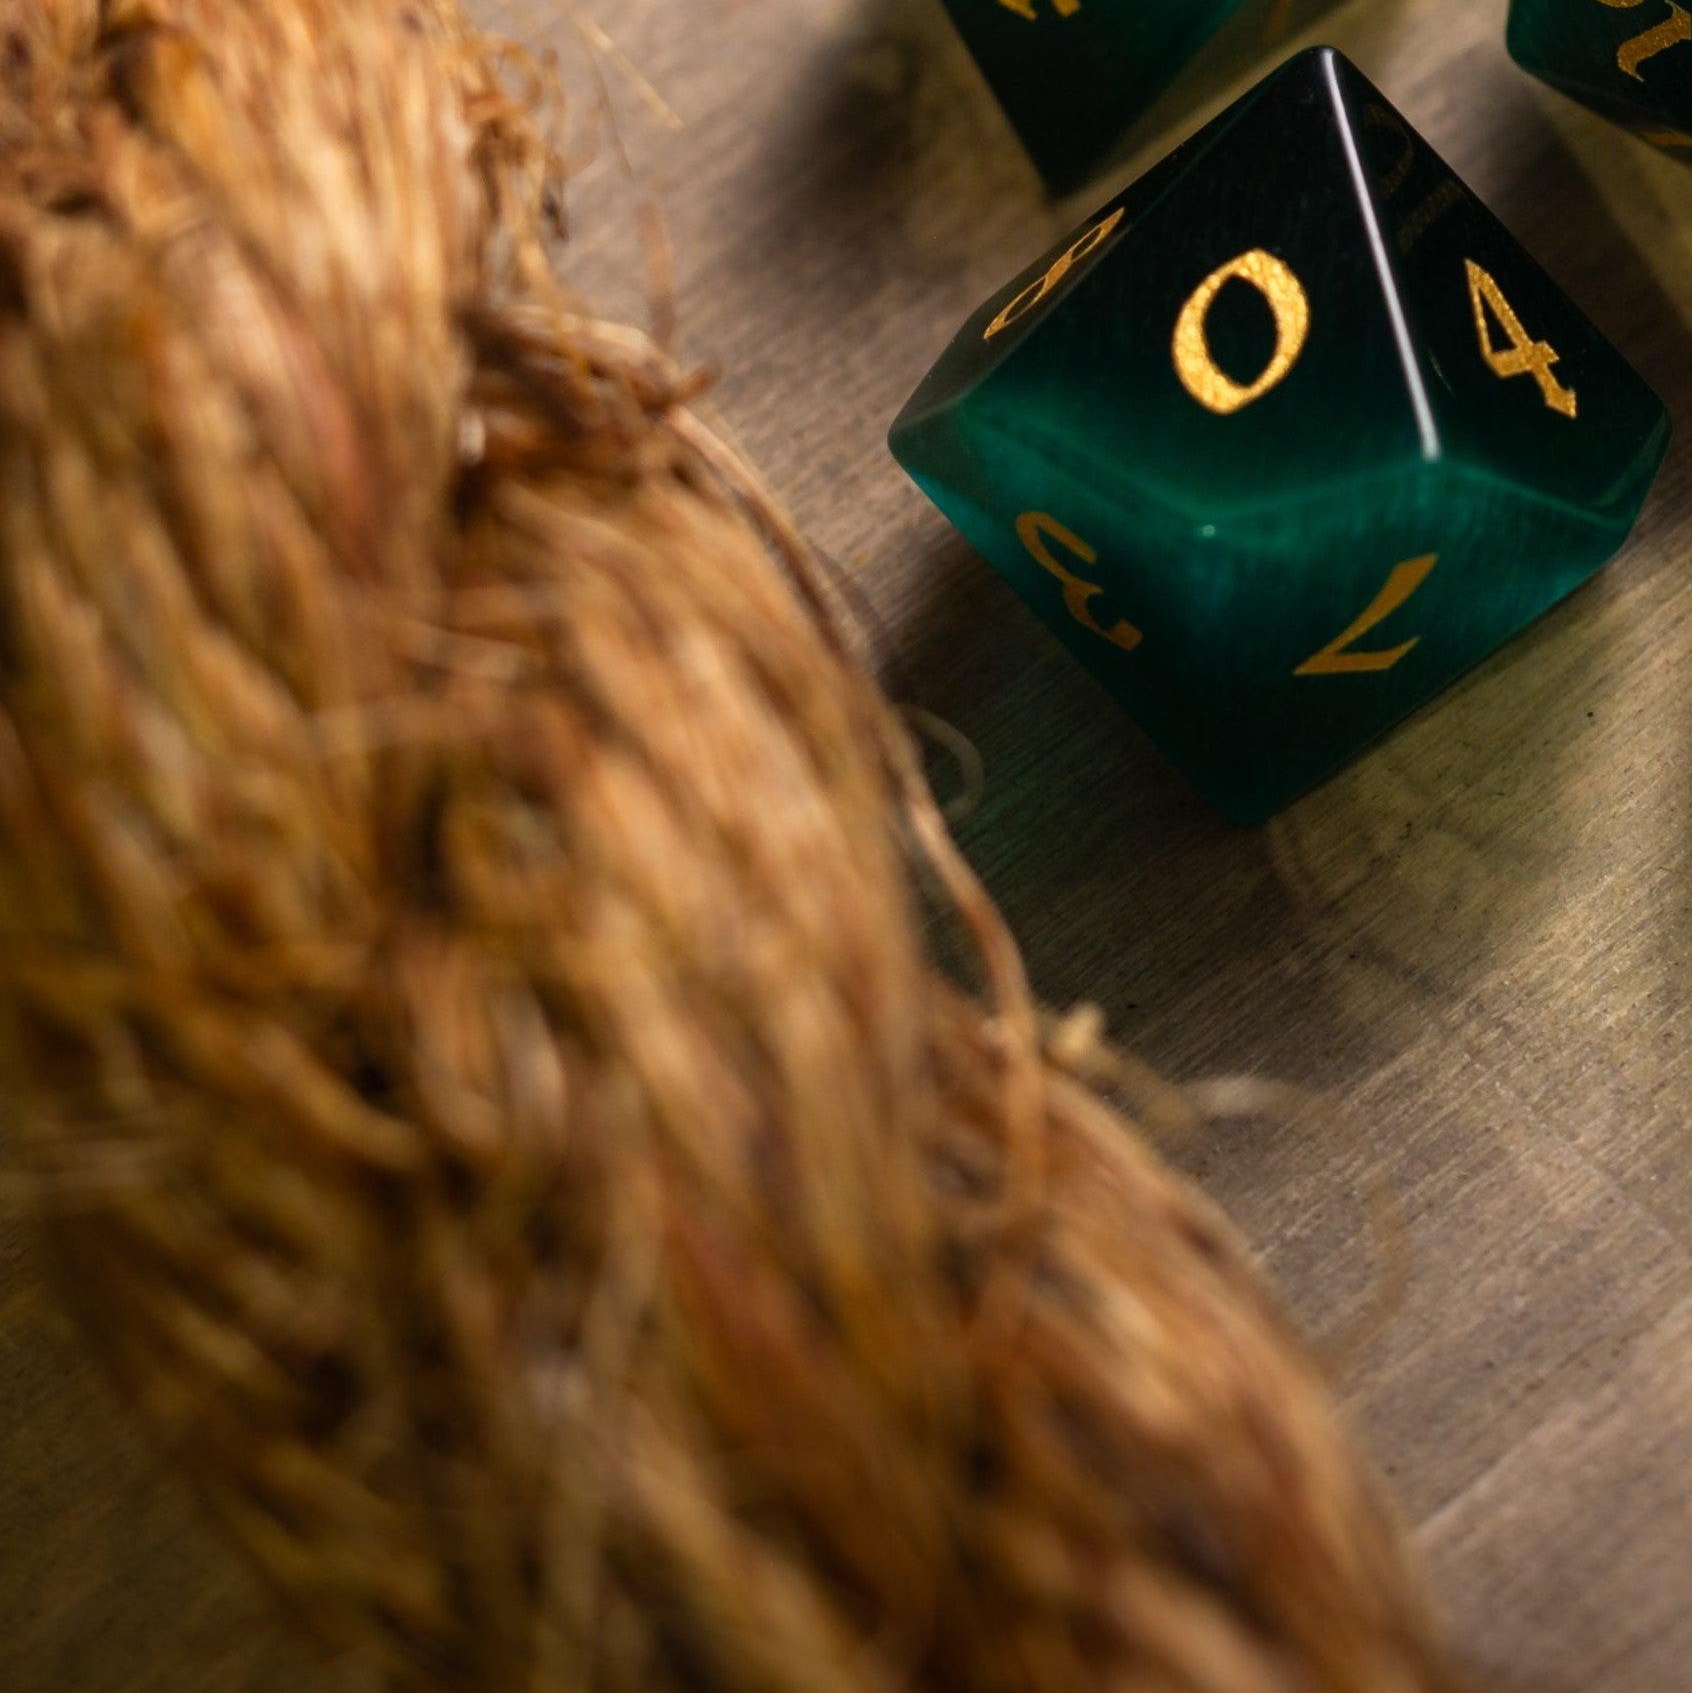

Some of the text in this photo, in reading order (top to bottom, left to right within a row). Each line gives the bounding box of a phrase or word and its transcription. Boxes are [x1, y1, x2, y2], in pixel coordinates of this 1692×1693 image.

[983, 207, 1125, 339] 8
[1172, 249, 1310, 414] 0
[1466, 261, 1577, 417] 4
[1015, 511, 1142, 650] 3
[1295, 554, 1436, 675] 7
